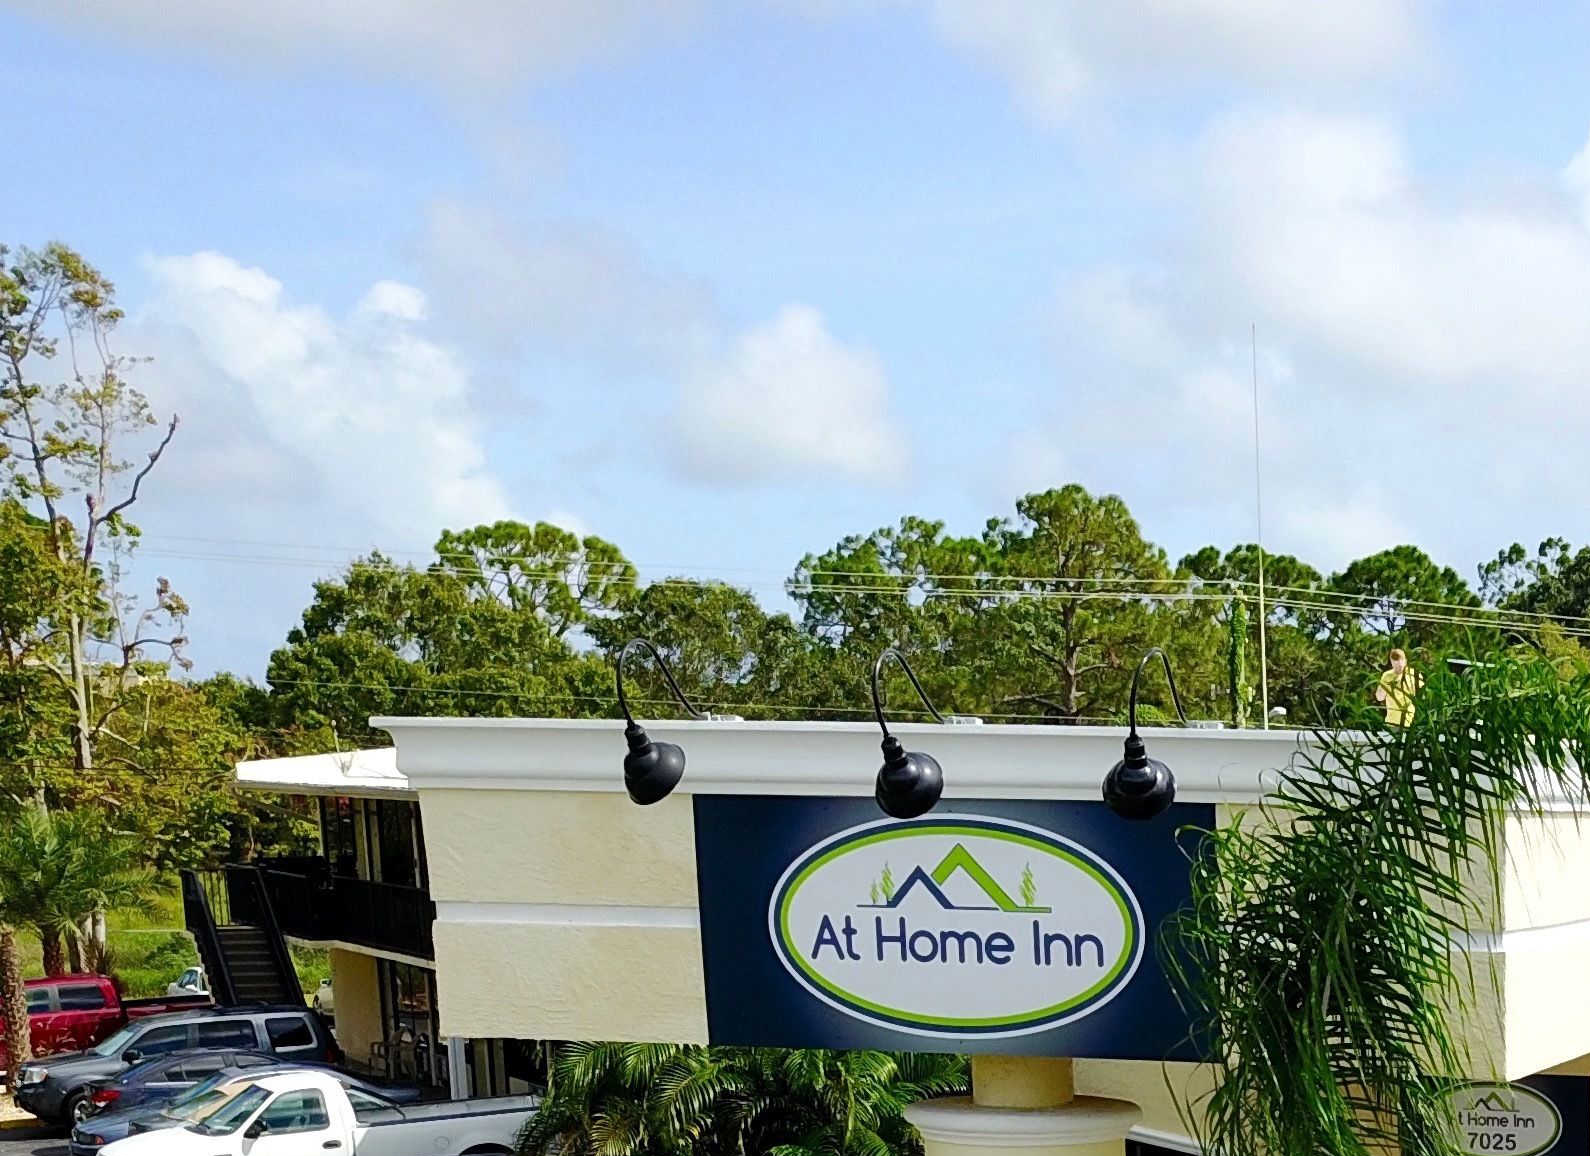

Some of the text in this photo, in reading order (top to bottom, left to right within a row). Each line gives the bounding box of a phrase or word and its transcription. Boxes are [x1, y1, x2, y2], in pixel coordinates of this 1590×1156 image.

[811, 915, 1104, 967] At Home Inn
[1467, 1112, 1509, 1127] Home
[1513, 1113, 1535, 1128] Inn
[1467, 1132, 1517, 1151] 7025
